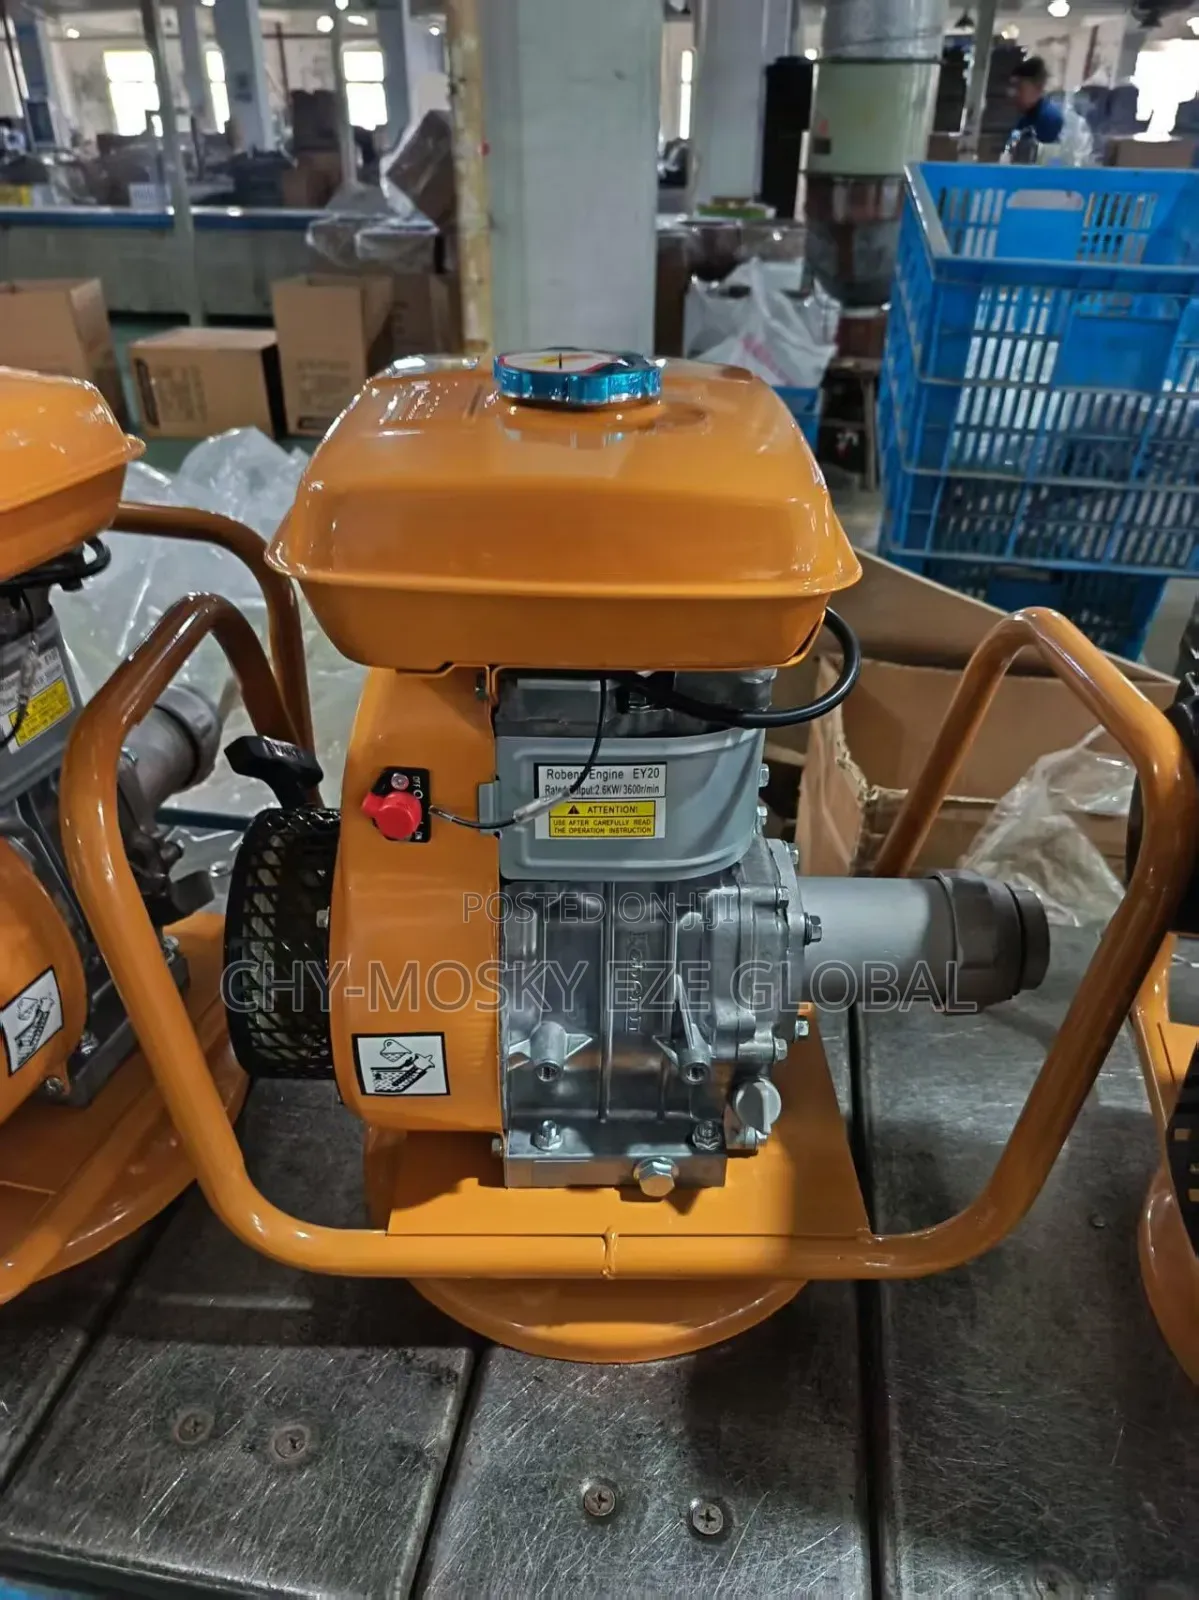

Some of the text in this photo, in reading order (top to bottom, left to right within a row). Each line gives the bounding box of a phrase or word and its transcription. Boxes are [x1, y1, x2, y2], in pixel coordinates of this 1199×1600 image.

[589, 768, 624, 782] Engine
[633, 768, 660, 779] EY20
[587, 805, 638, 814] ATTENTION:
